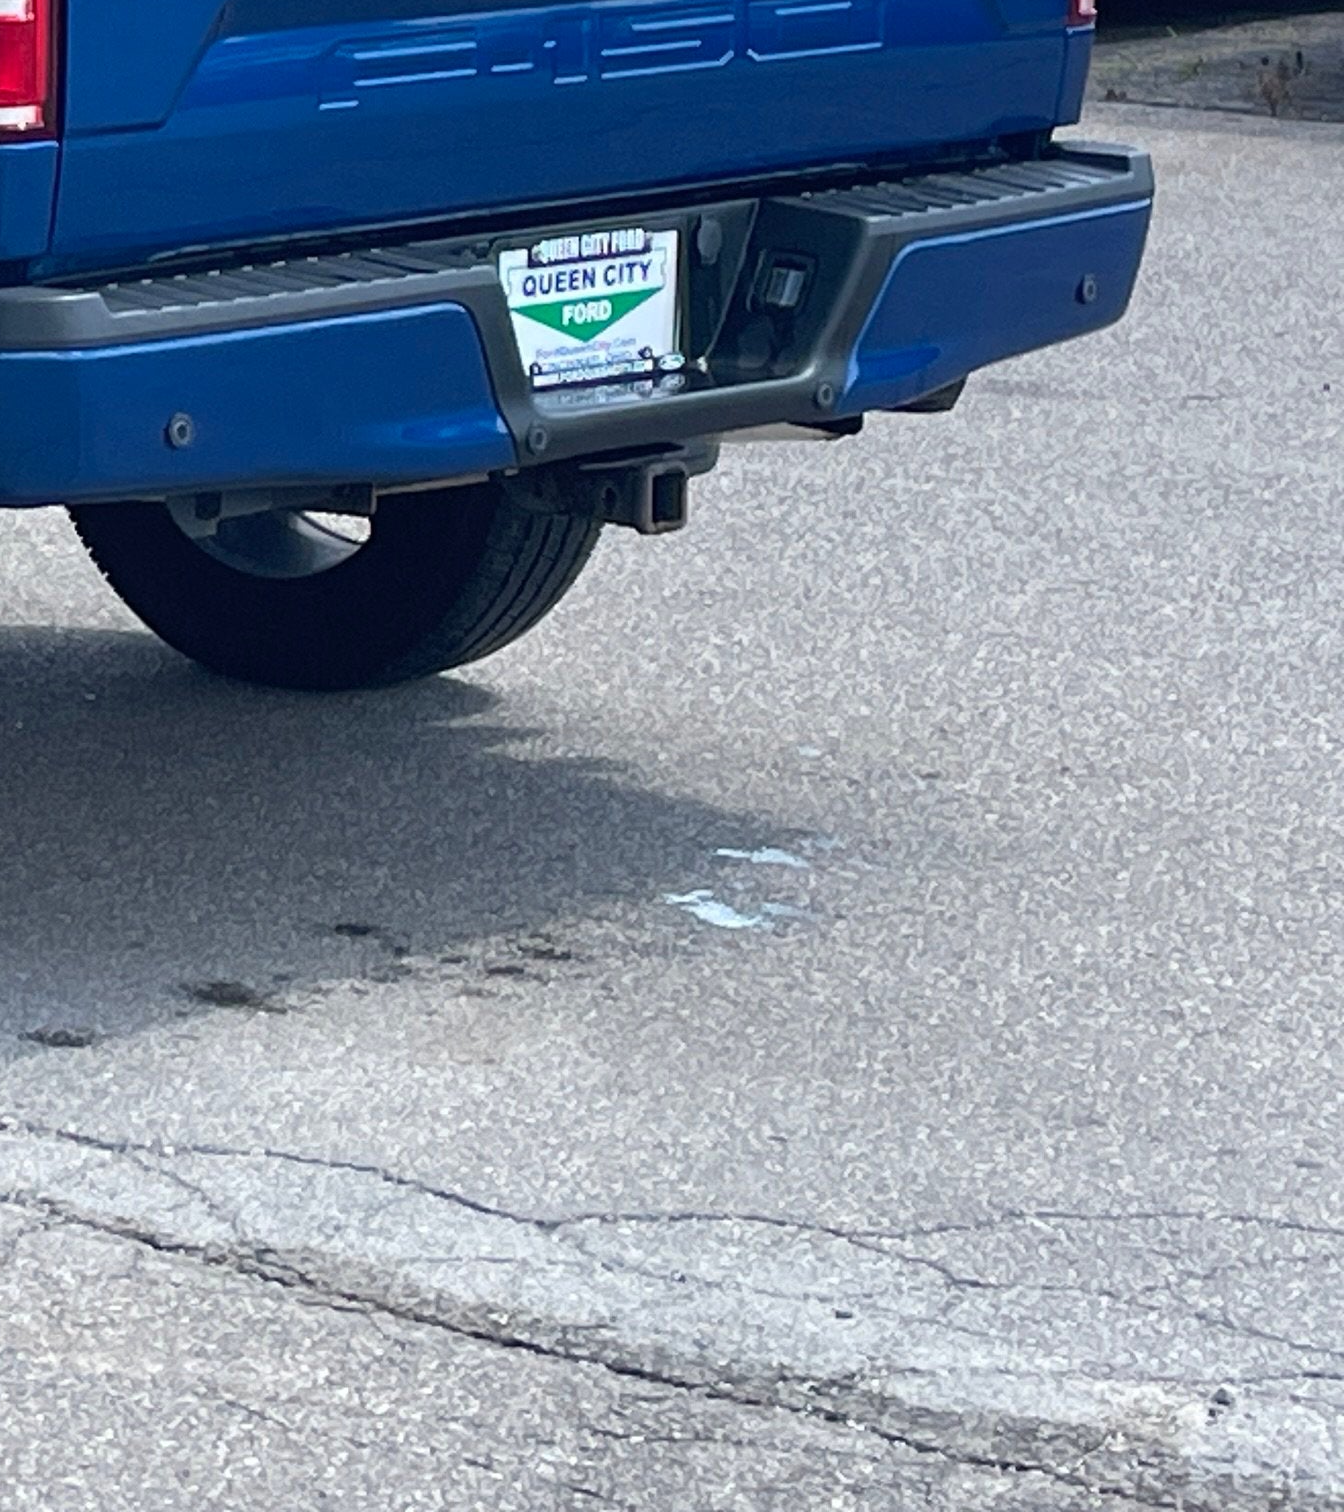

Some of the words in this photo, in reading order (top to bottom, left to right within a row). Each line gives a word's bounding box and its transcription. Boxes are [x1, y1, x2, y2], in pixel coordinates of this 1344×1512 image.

[522, 269, 596, 297] QUEEN
[603, 258, 653, 287] CITY
[562, 299, 612, 326] FORD
